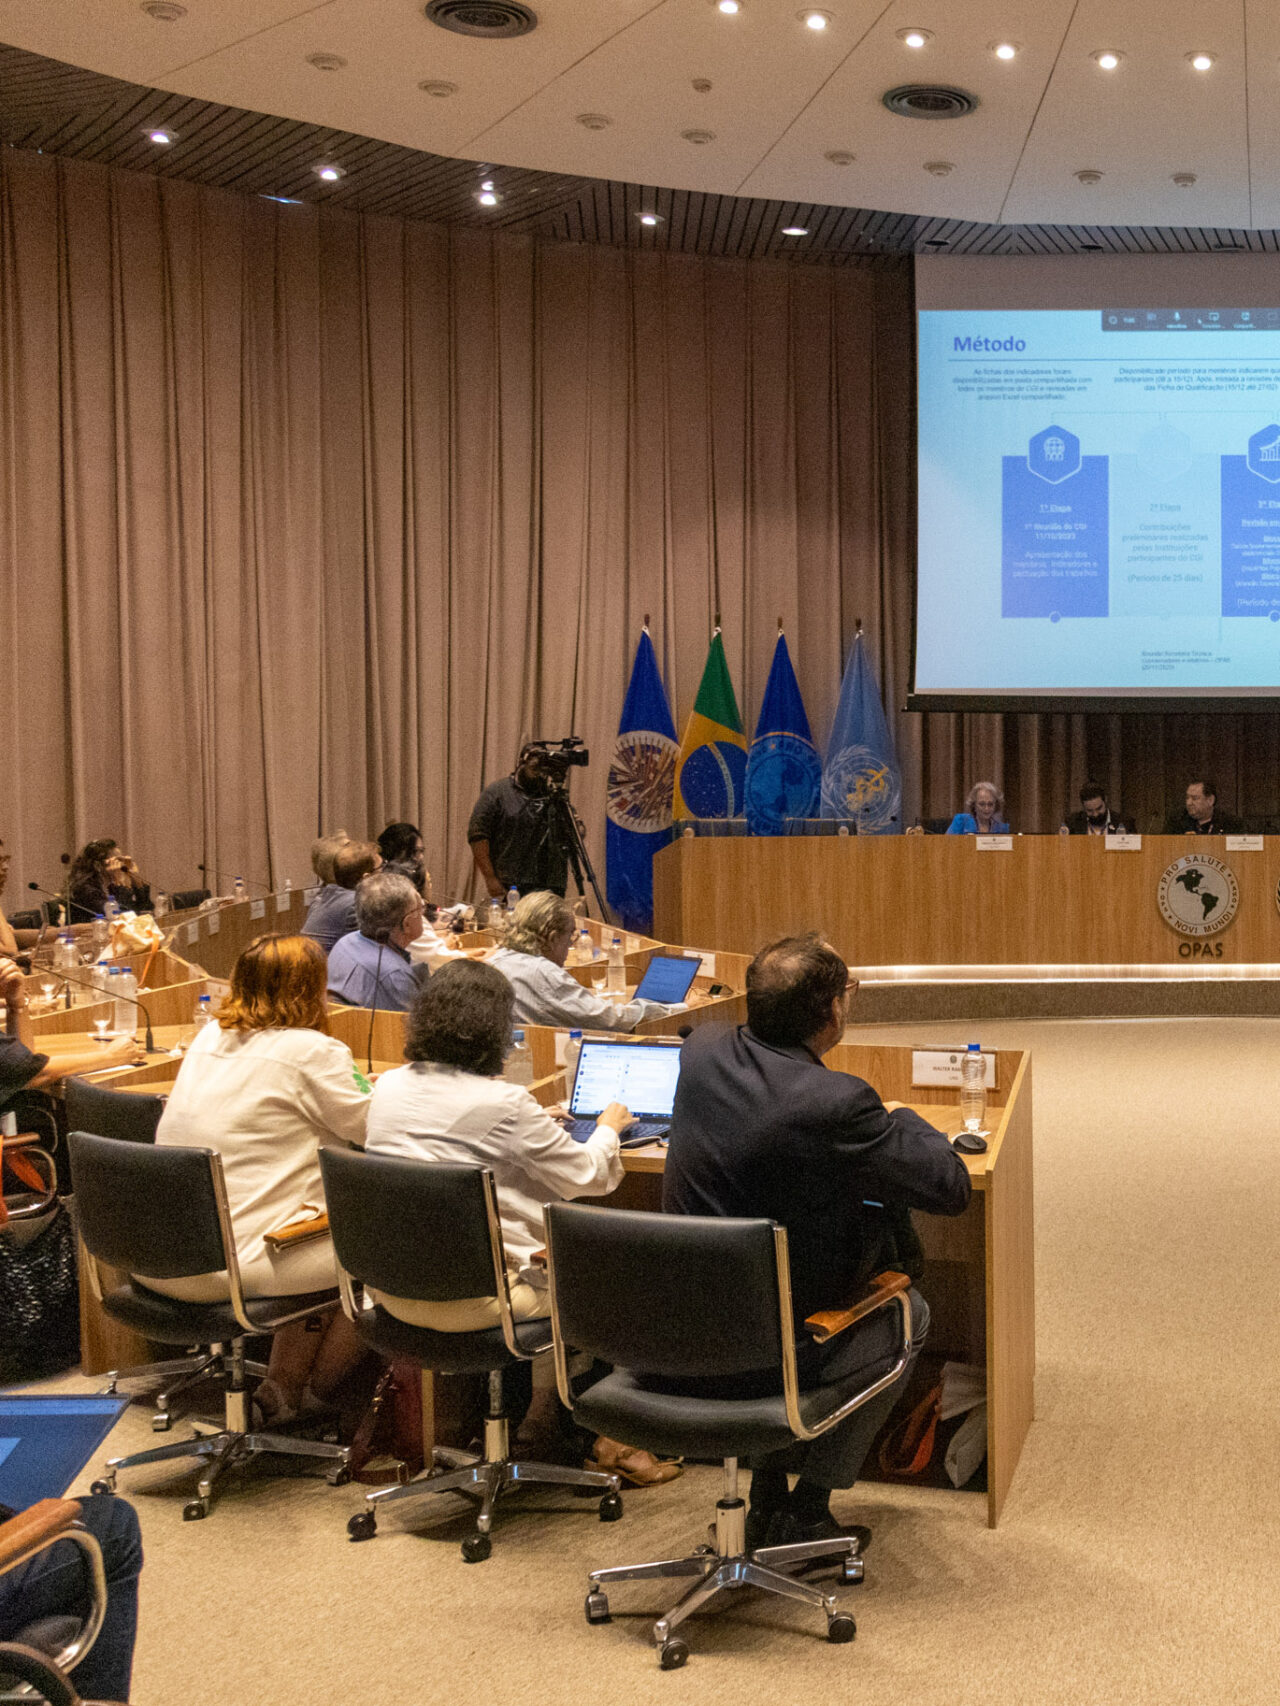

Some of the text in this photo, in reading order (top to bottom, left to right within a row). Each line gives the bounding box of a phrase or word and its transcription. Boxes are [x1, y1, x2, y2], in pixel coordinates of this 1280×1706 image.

[954, 336, 1026, 351] Método
[1161, 855, 1228, 884] PRO SALUTE
[1174, 911, 1232, 933] NOVI MUNDI
[1178, 943, 1223, 958] OPAS
